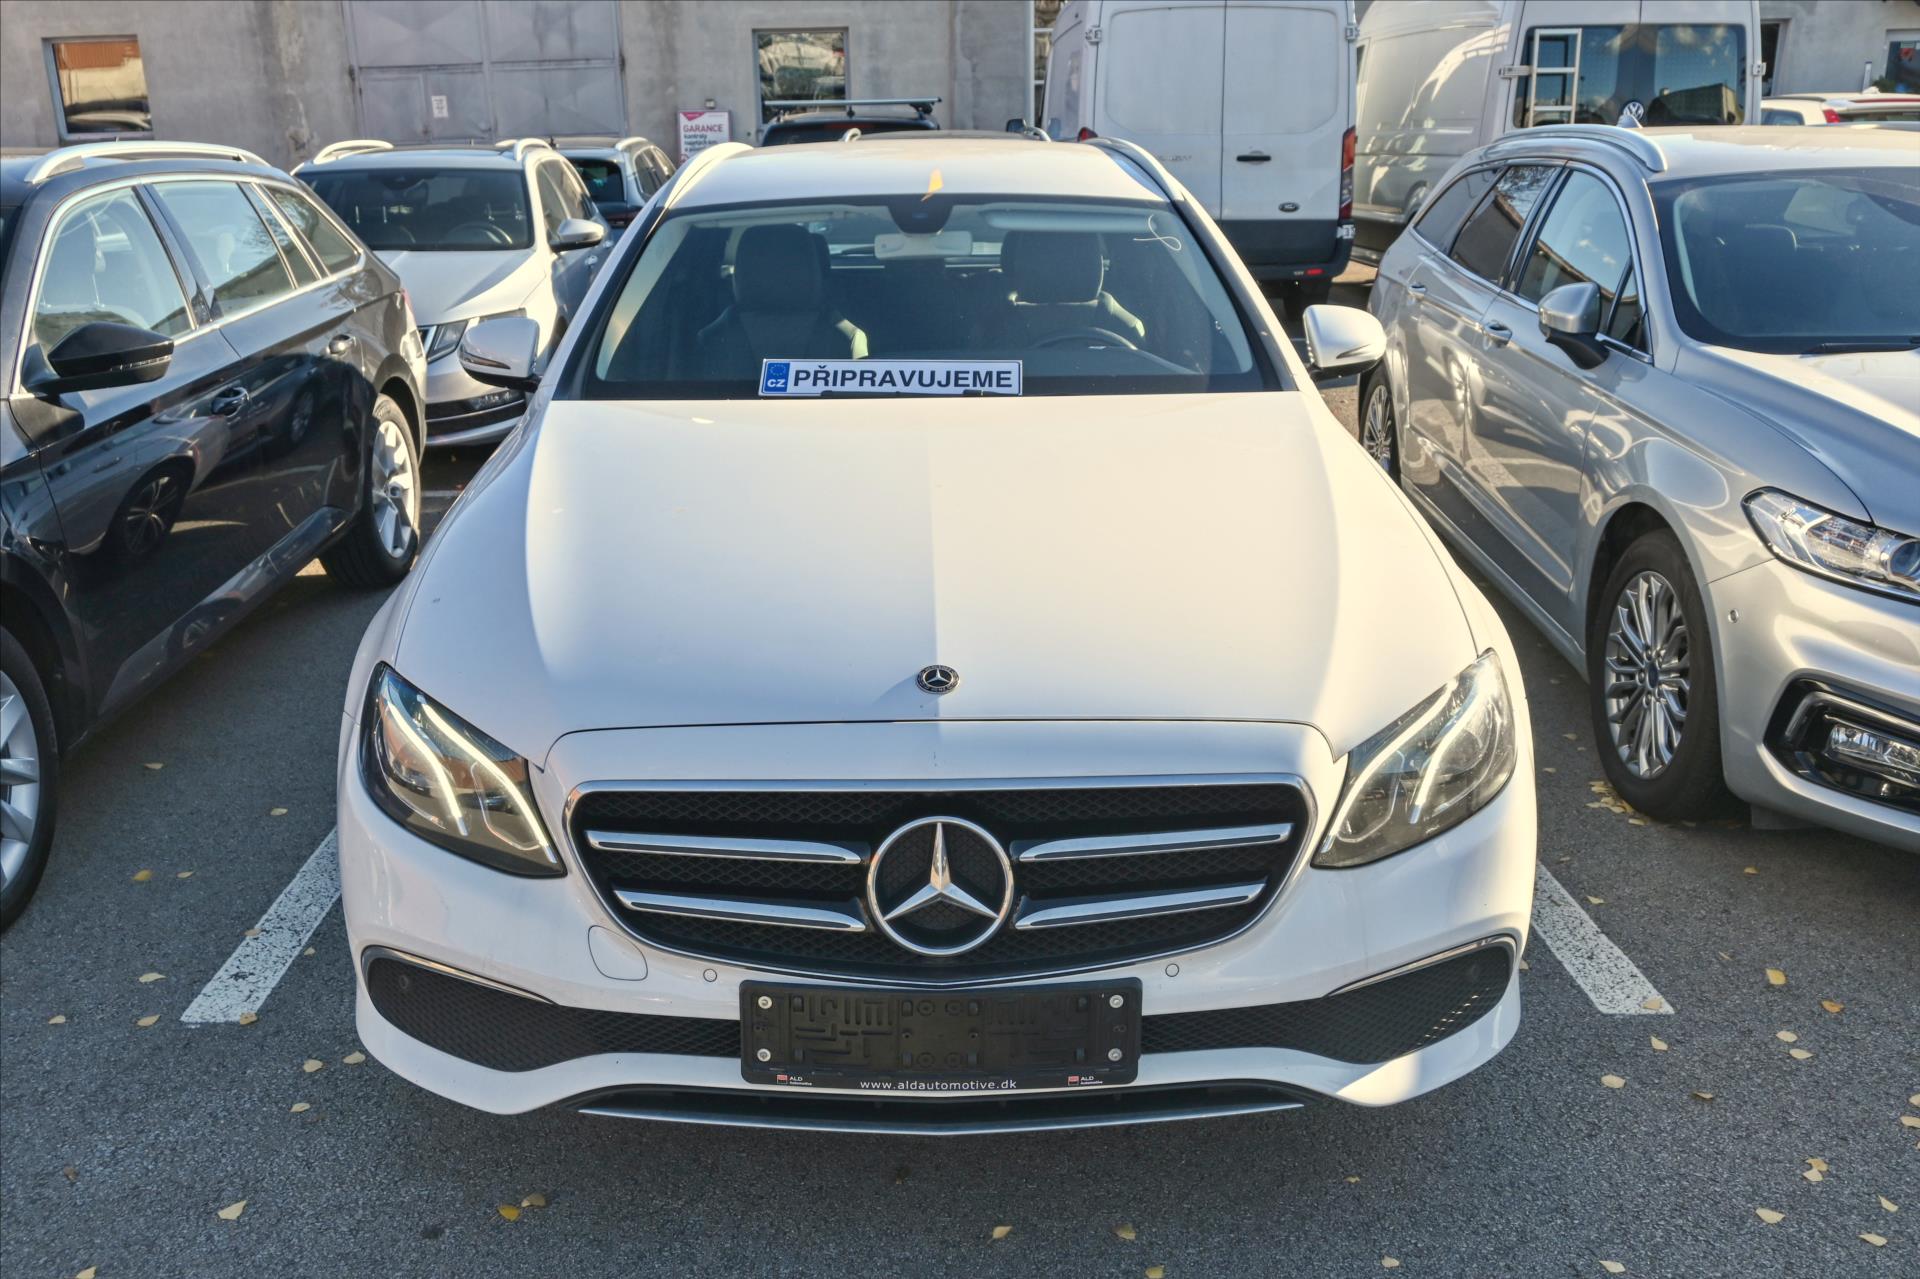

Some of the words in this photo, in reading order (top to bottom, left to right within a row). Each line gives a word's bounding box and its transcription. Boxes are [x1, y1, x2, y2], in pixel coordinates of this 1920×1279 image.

[683, 124, 723, 132] GARANCE
[767, 379, 785, 388] CZ
[793, 365, 1013, 388] PŘIPRAVUJEME
[860, 1080, 1017, 1090] www.aldautomotive.dk
